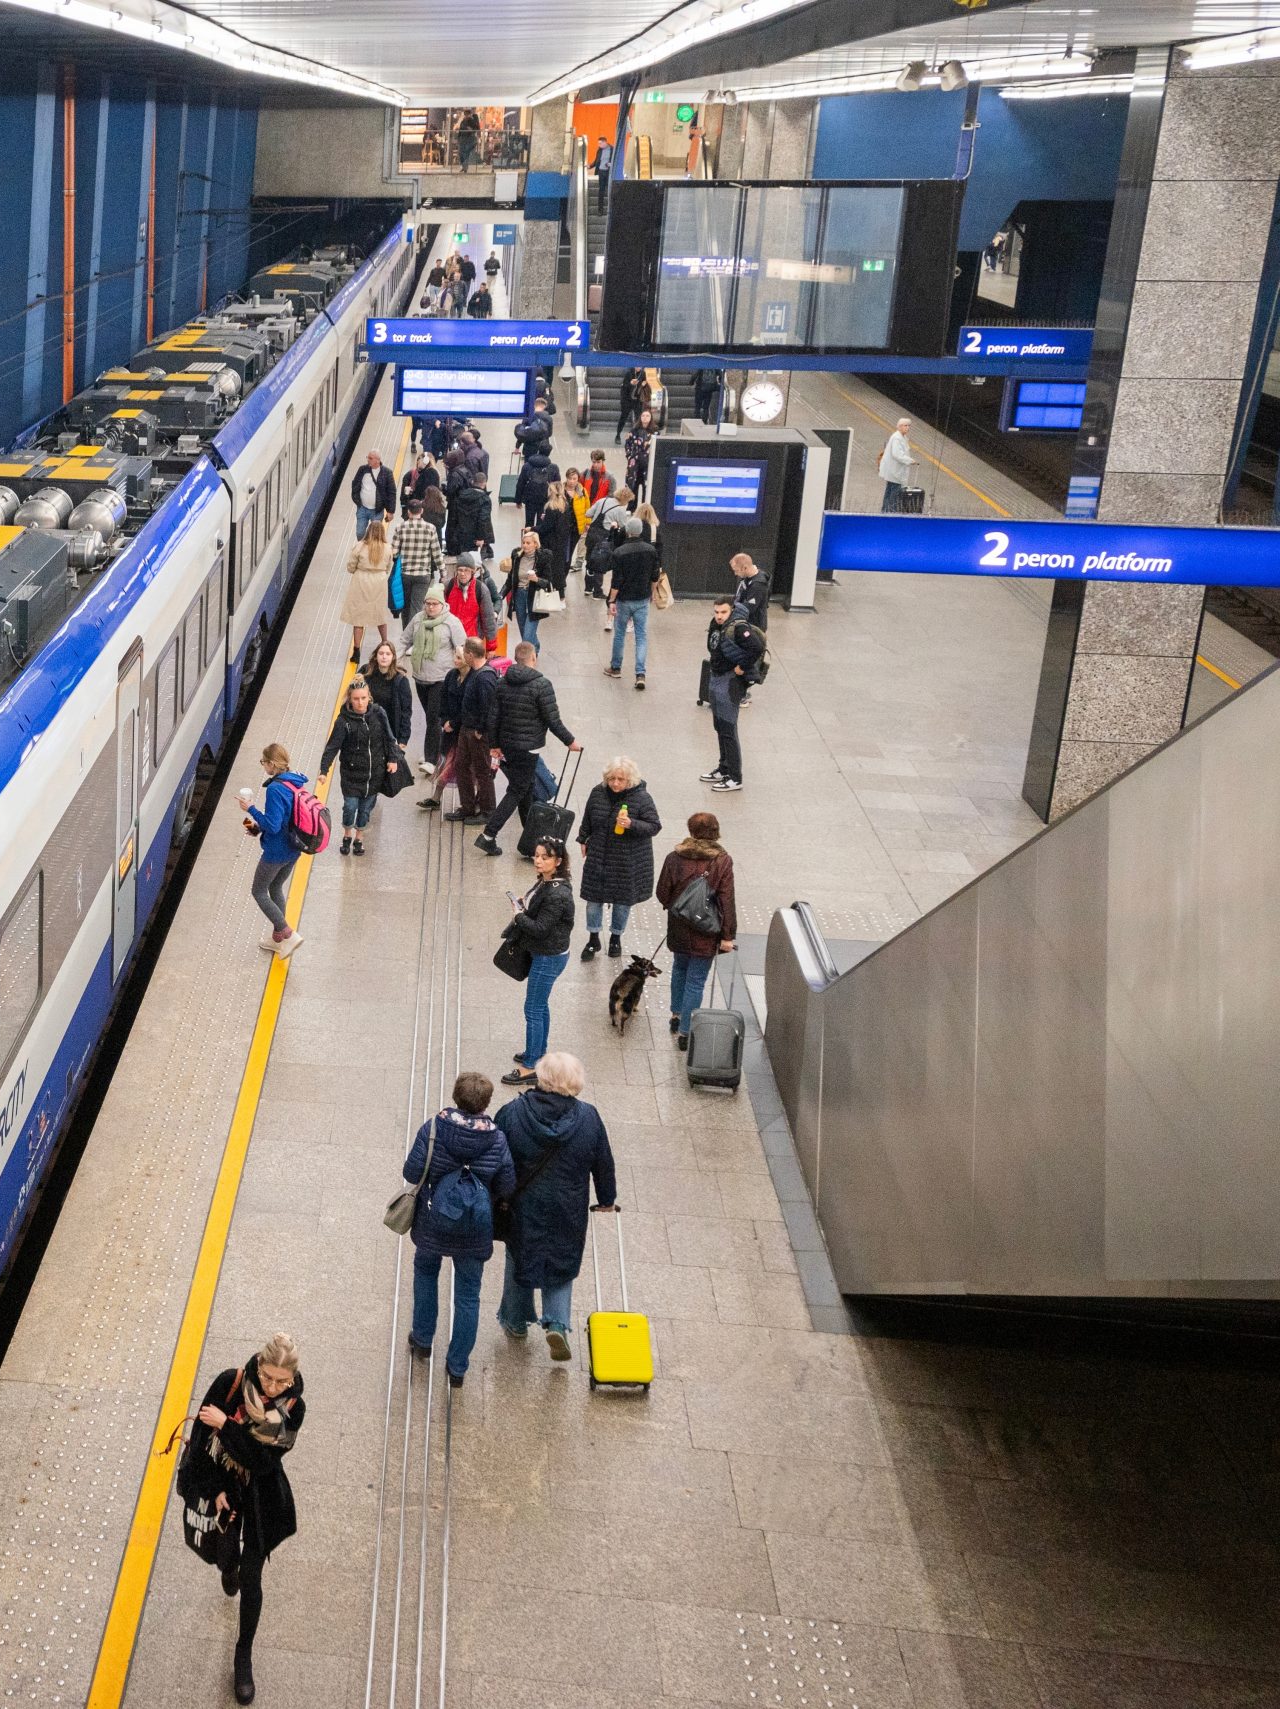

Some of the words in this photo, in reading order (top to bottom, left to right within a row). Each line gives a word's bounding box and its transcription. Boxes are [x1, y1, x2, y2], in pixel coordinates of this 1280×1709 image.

[373, 323, 387, 343] 3
[392, 334, 406, 343] tor
[409, 333, 432, 343] track
[490, 335, 517, 346] peron
[520, 334, 560, 346] platform
[566, 325, 582, 346] 2
[964, 331, 982, 353] 2
[986, 344, 1018, 355] peron
[1020, 343, 1065, 356] platform
[979, 531, 1010, 567] 2
[1013, 552, 1075, 571] peron
[1081, 551, 1173, 574] platform
